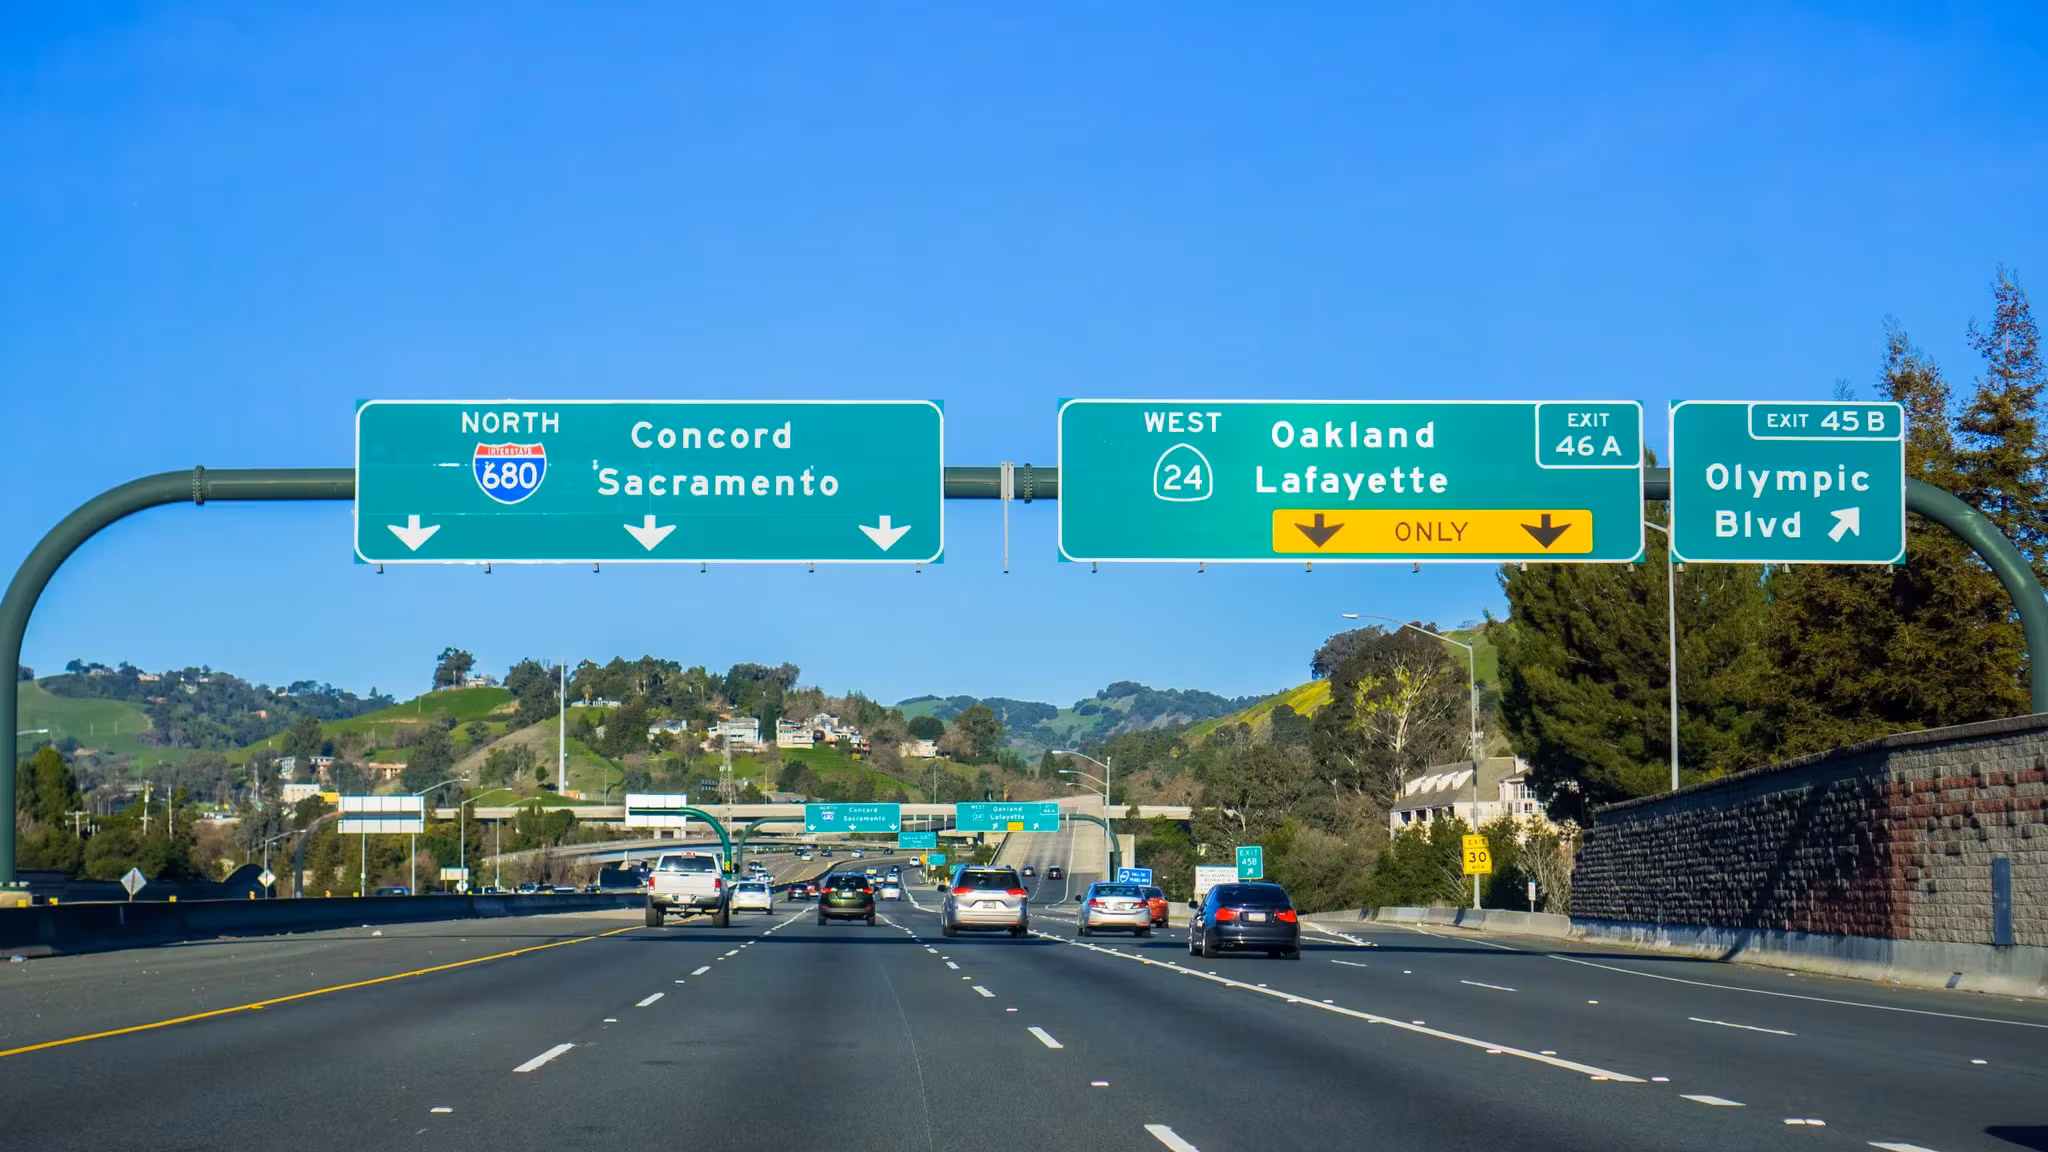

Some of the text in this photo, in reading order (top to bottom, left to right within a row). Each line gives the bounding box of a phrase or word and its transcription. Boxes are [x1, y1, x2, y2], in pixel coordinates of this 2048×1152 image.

[461, 411, 559, 434] NORTH
[1143, 411, 1222, 433] WEST
[1567, 413, 1610, 427] EXIT
[1767, 410, 1885, 432] EXIT 45 B
[631, 421, 791, 449] Concord
[1271, 420, 1435, 449] Oakland
[487, 447, 533, 456] INTERSTATE
[1555, 435, 1622, 457] 46 A
[482, 461, 538, 490] 680
[597, 467, 839, 497] Sacramento
[1163, 464, 1203, 491] 24
[1255, 465, 1448, 501] Lafayette
[1705, 462, 1869, 499] Olympic
[1395, 521, 1468, 542] ONLY
[1715, 509, 1801, 539] Blvd
[1239, 849, 1258, 857] EXIT
[1468, 838, 1486, 846] EXIT
[1468, 851, 1487, 863] 30
